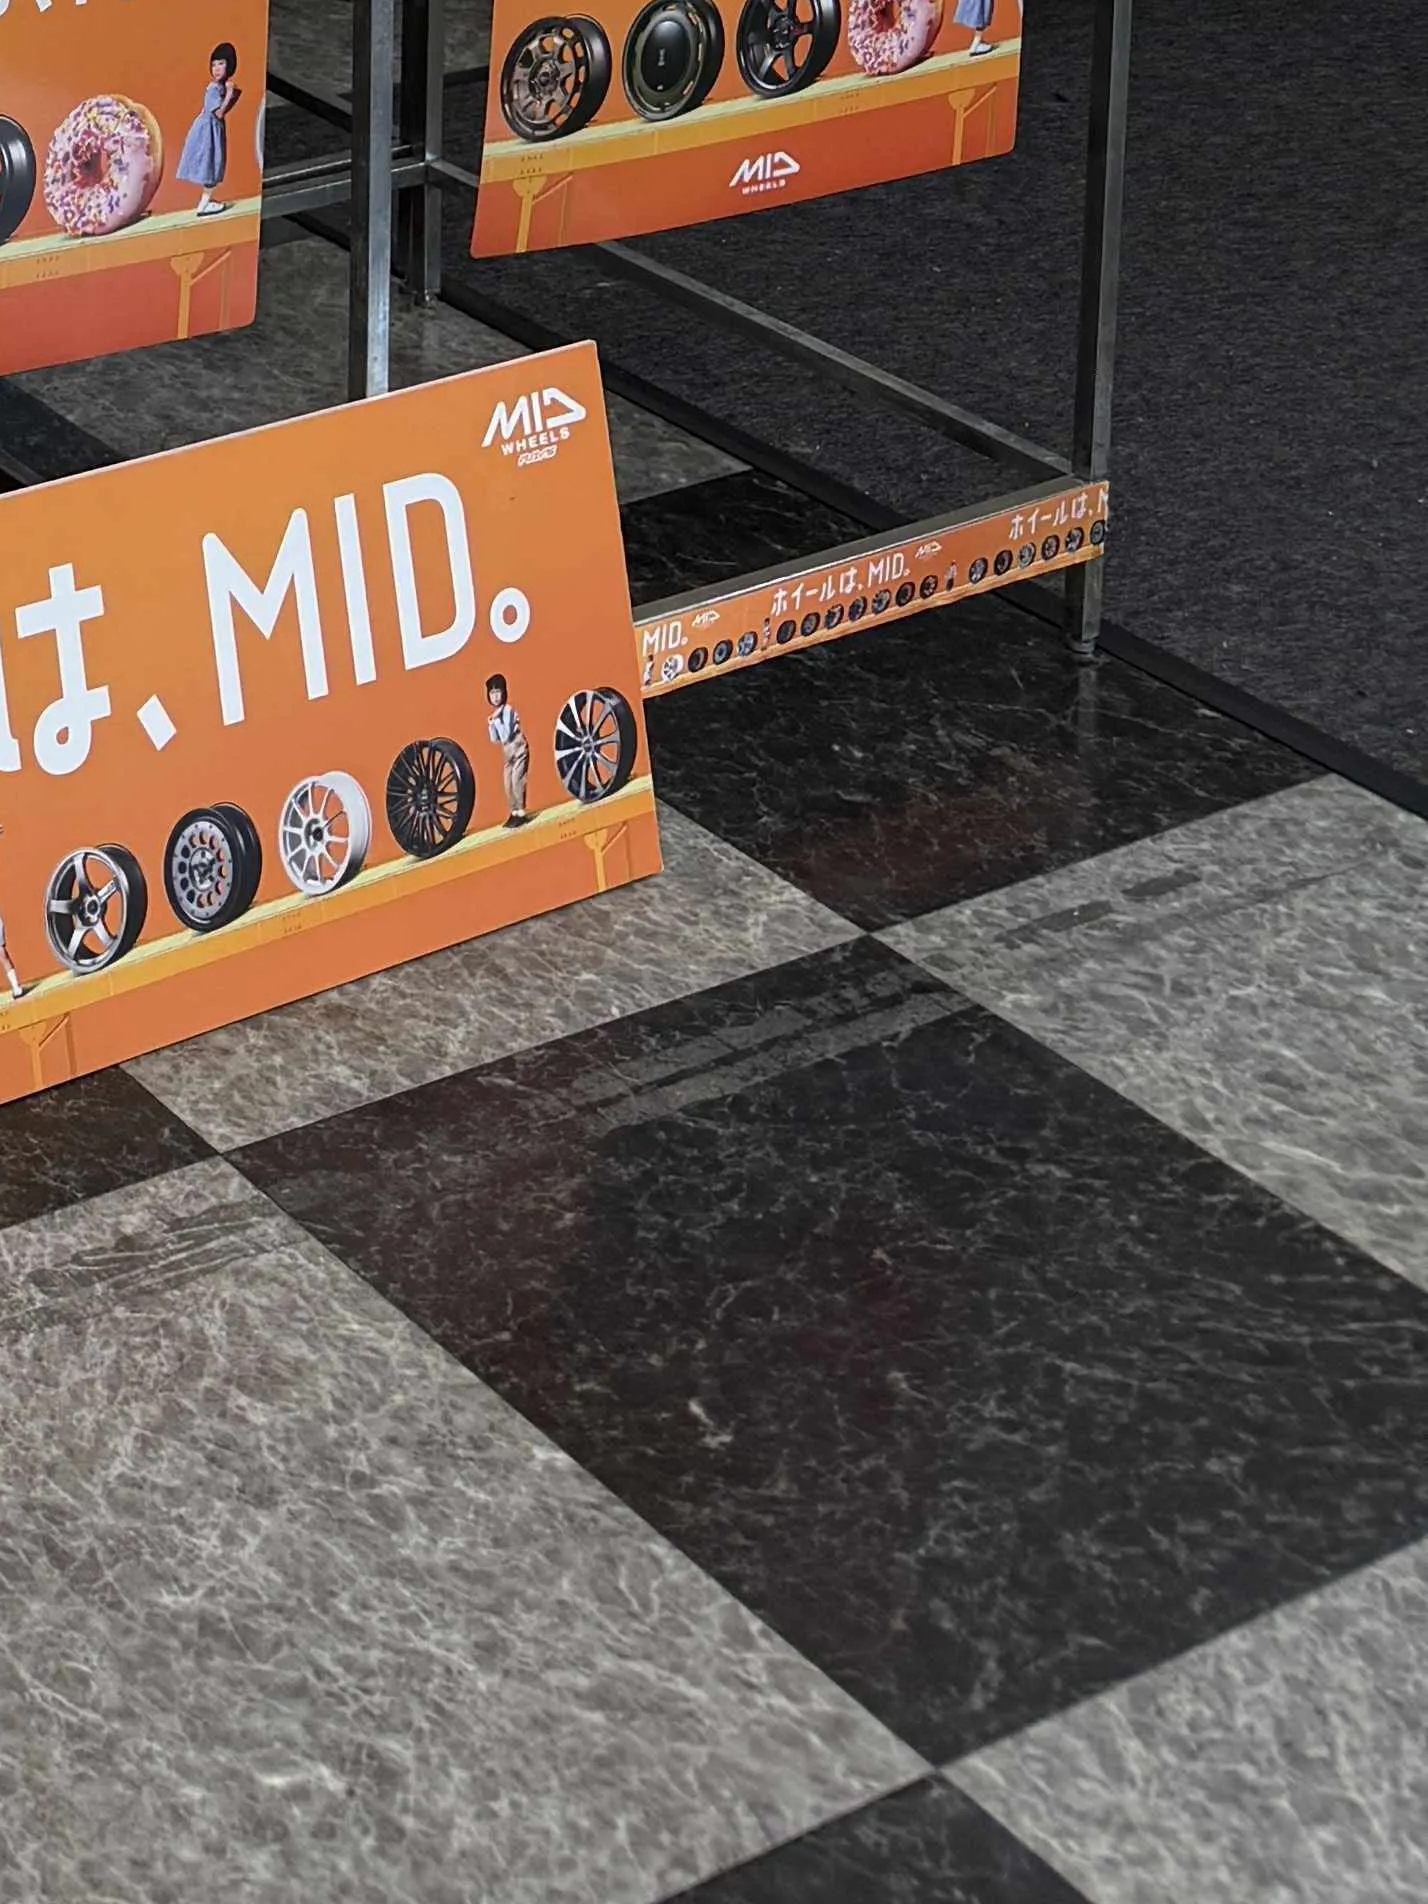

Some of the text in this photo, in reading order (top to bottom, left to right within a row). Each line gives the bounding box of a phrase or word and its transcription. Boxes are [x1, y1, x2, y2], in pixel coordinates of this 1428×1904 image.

[729, 150, 802, 188] MID
[481, 386, 588, 450] MID
[500, 426, 571, 457] WHEELS
[770, 551, 912, 617] ホイールは、MID。
